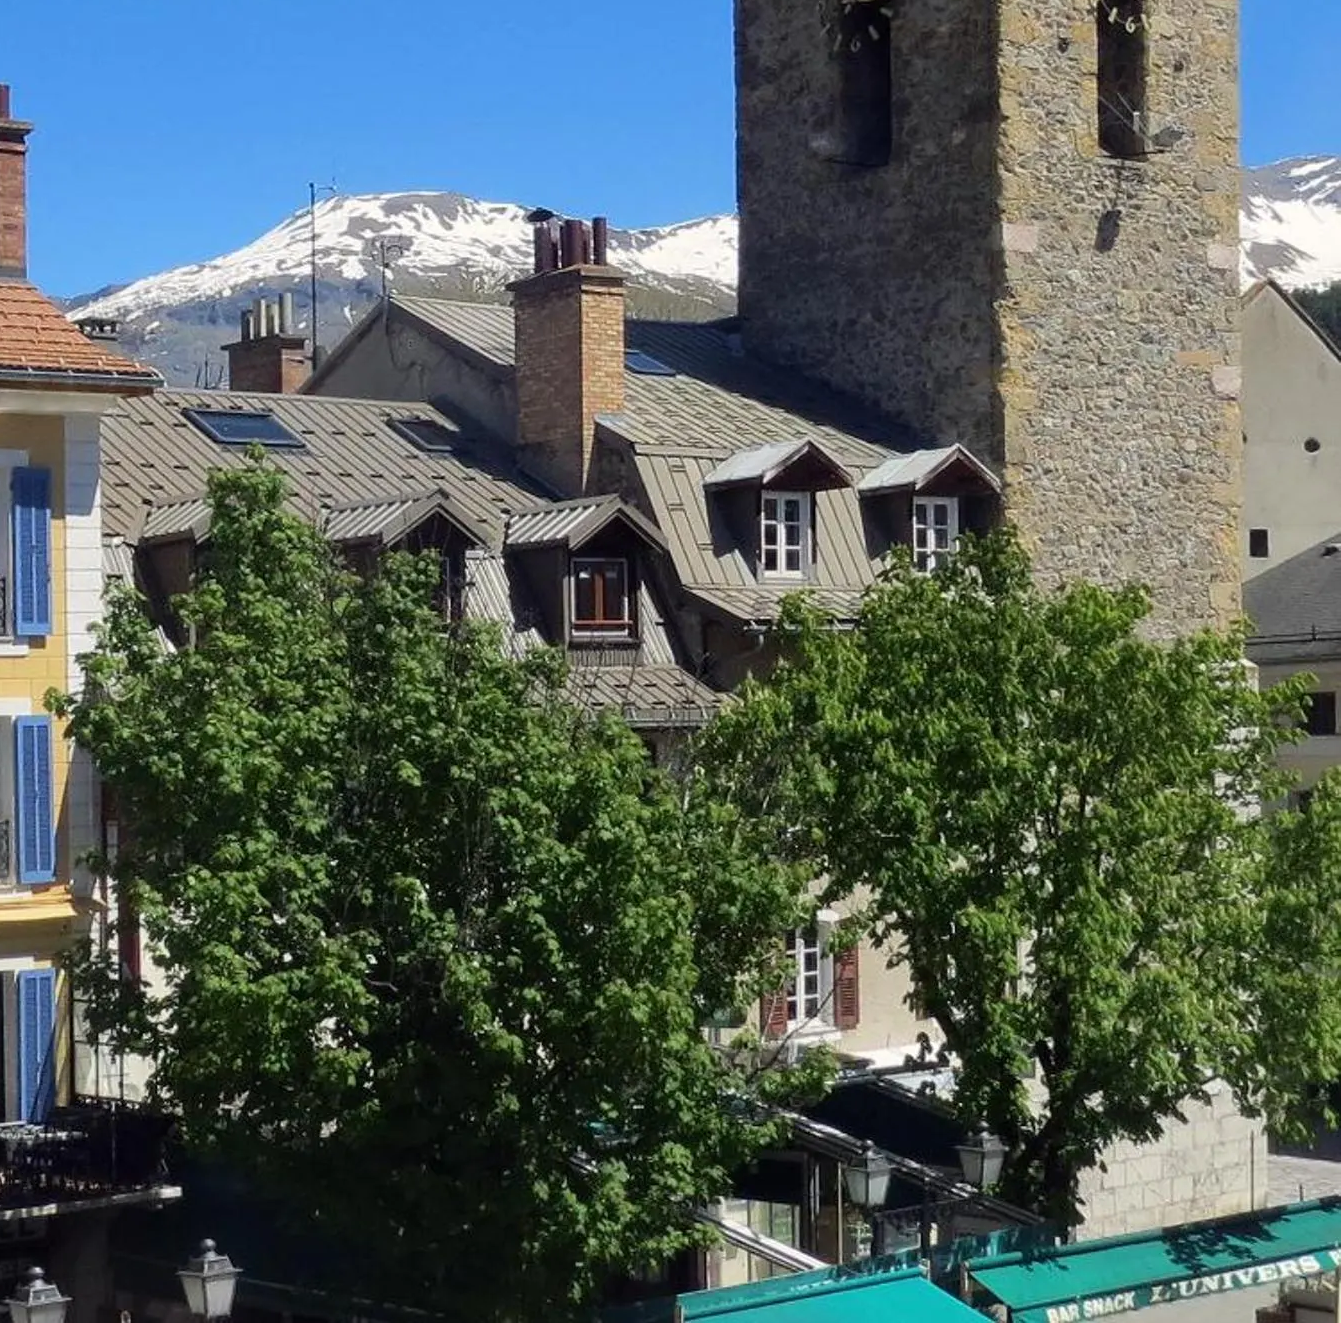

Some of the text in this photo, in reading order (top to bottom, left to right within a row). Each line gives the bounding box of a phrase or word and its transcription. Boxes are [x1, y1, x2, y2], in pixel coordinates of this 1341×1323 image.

[1046, 1303, 1080, 1323] BAR
[1083, 1290, 1136, 1318] SNACK
[1149, 1254, 1320, 1303] L'UNIVERS
